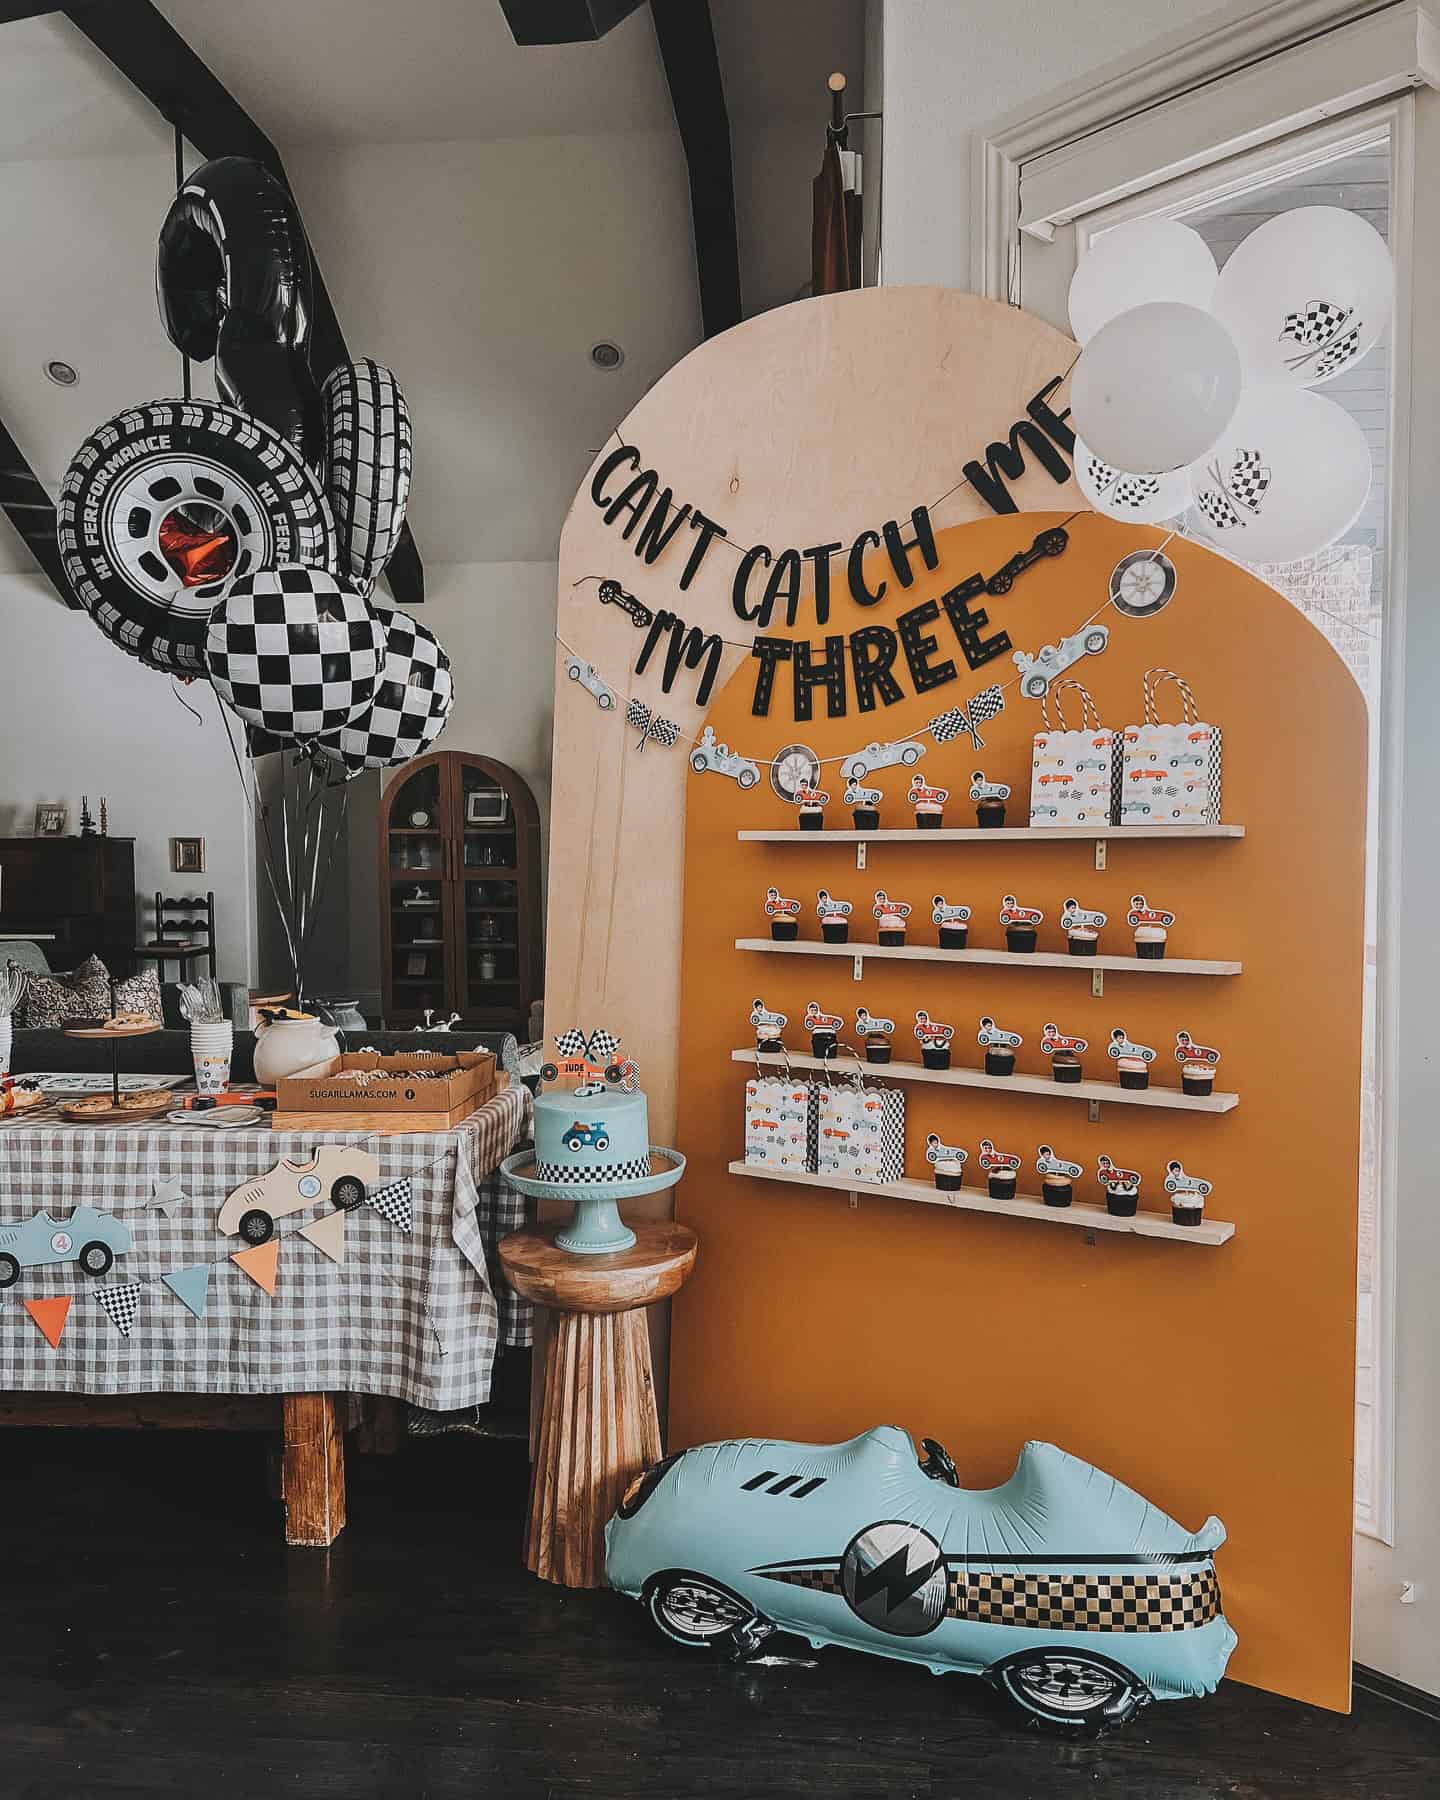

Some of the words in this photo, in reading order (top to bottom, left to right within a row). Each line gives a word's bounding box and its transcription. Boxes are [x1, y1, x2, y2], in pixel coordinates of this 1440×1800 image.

[256, 482, 280, 507] HI
[591, 445, 727, 591] CAN'T
[732, 504, 939, 628] CATCH
[91, 554, 113, 580] HI
[634, 609, 723, 707] I'M
[751, 572, 1014, 722] THREE
[565, 1063, 585, 1073] JUDE
[610, 1056, 618, 1064] 3
[309, 1089, 398, 1100] SUGARLLAMAS.COM
[56, 1235, 68, 1249] 4
